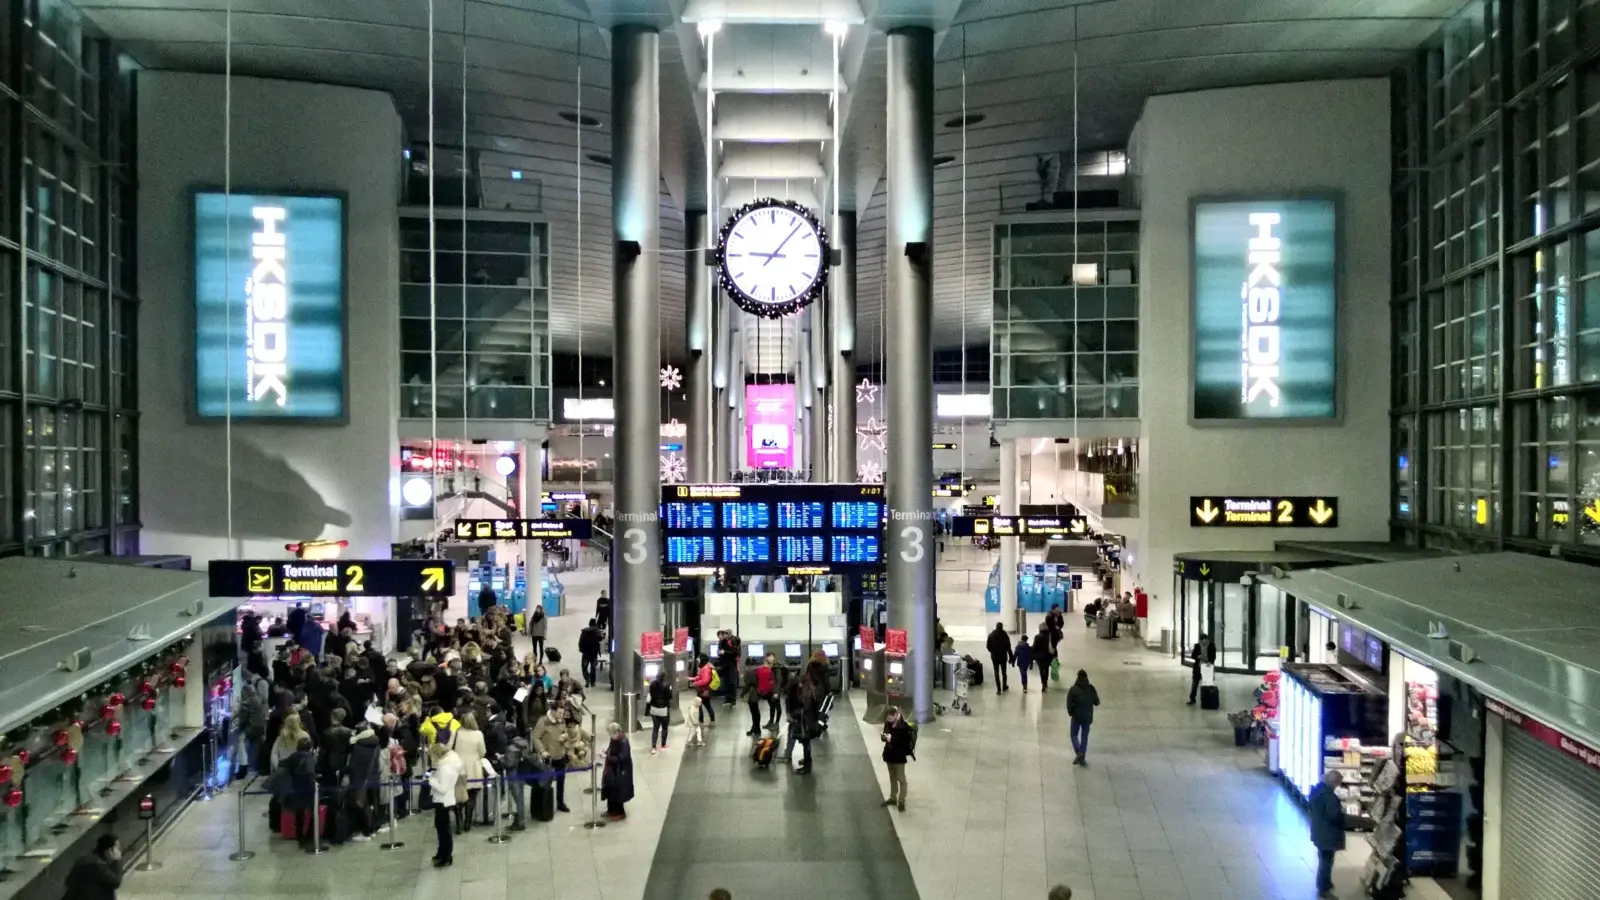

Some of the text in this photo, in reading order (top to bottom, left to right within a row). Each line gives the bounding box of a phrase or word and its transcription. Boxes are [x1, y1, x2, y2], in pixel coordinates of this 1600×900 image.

[1224, 499, 1293, 522] Terminal 2
[1224, 511, 1272, 522] Terminal
[521, 521, 527, 537] 1
[1018, 518, 1024, 533] 1
[623, 528, 648, 565] 3
[900, 526, 925, 563] 3
[283, 564, 364, 592] Terminal 2
[283, 578, 338, 592] Terminal
